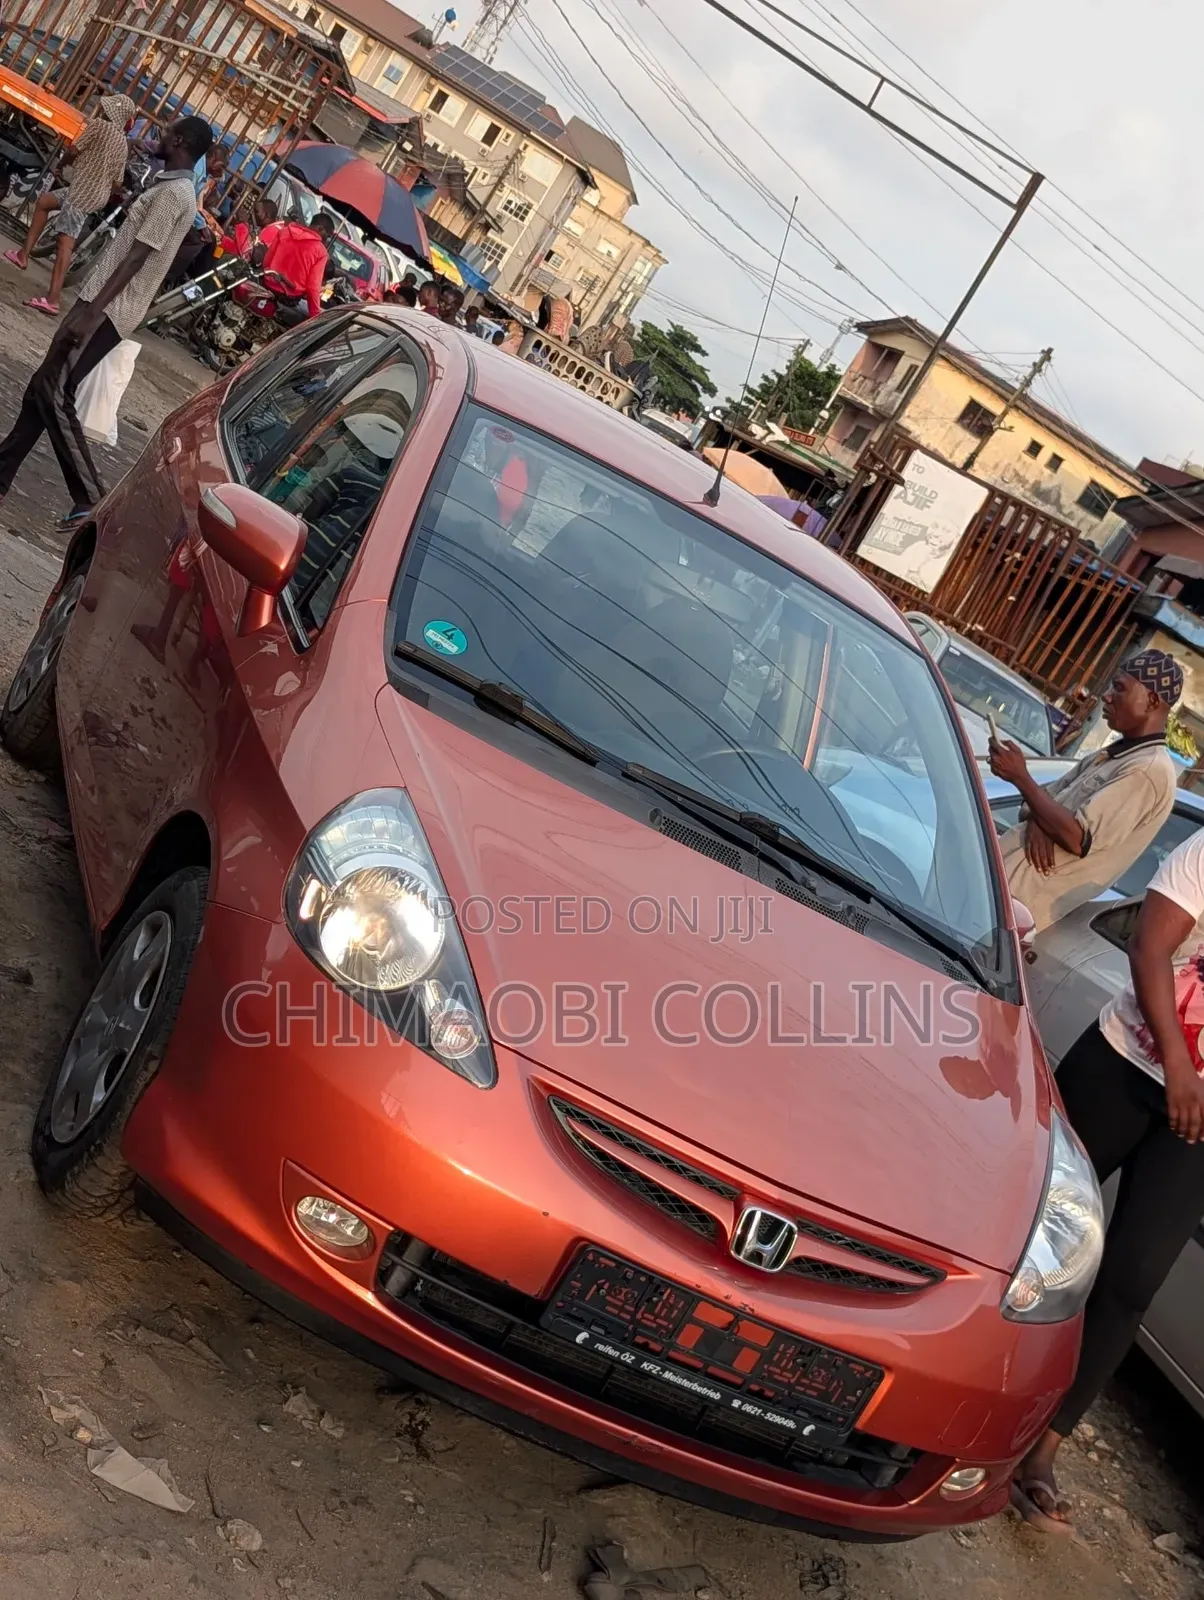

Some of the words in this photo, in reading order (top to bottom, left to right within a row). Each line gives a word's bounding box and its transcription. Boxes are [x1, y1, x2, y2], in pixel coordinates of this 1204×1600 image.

[911, 463, 925, 475] TO
[905, 480, 938, 500] BUILD
[893, 489, 935, 511] AJIF
[442, 627, 457, 640] 4
